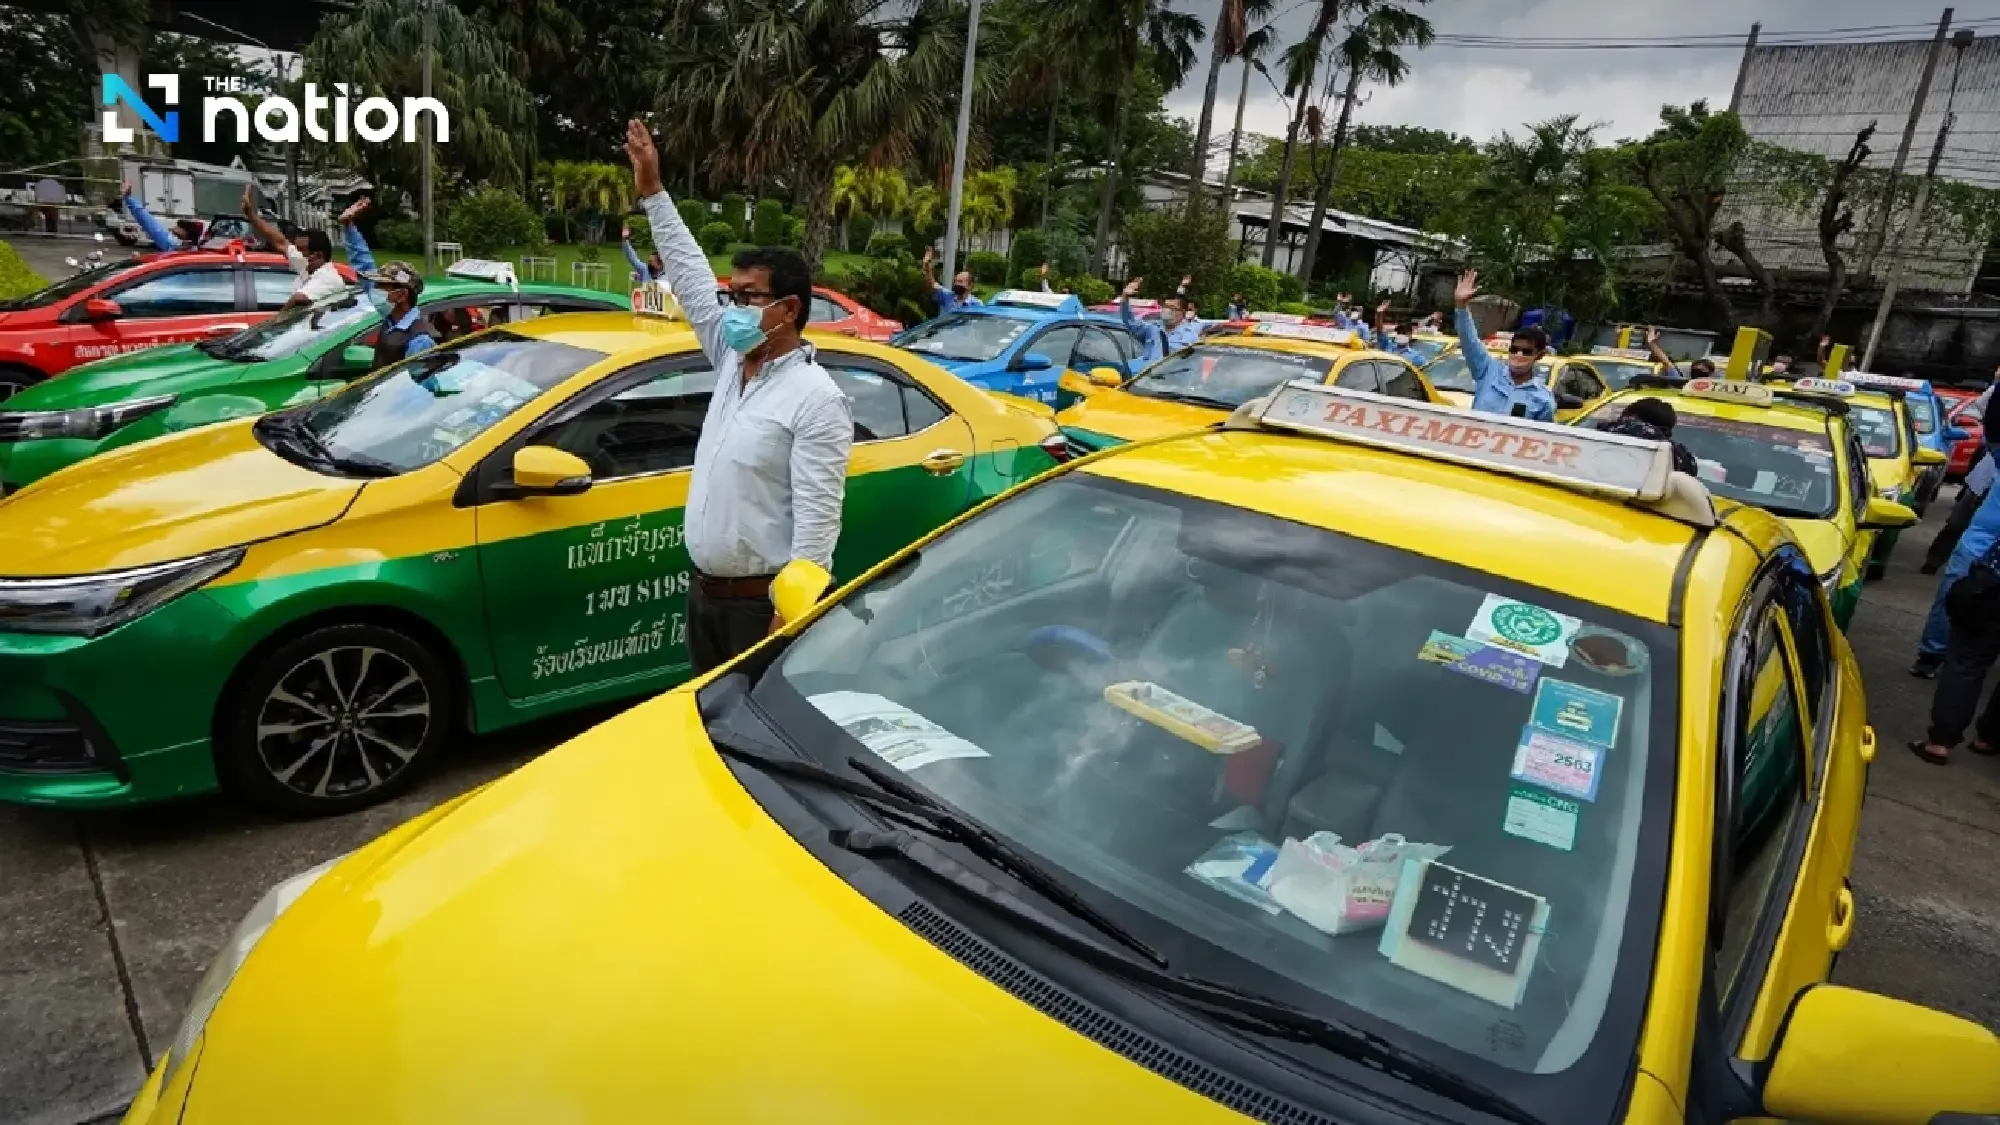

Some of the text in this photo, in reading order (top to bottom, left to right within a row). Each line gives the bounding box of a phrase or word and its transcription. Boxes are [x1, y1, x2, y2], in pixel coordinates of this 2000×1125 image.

[1321, 401, 1584, 470] TAXI-METER
[636, 570, 690, 604] 8198
[532, 612, 667, 680] ร้องเรียนแท็กซี่
[1456, 661, 1528, 691] COVID-19
